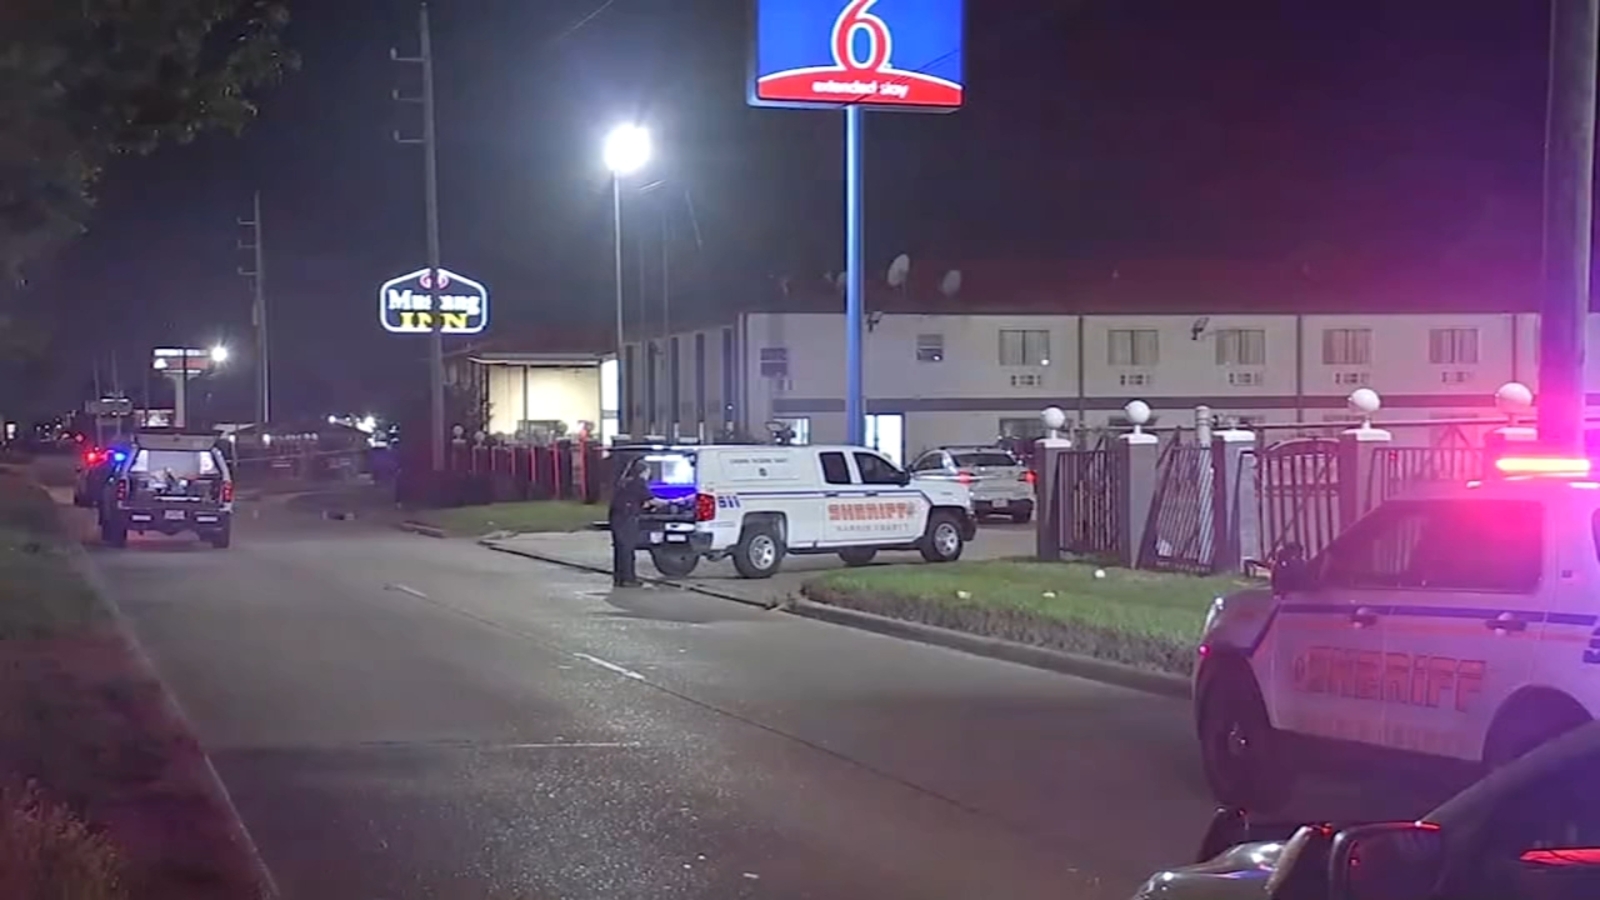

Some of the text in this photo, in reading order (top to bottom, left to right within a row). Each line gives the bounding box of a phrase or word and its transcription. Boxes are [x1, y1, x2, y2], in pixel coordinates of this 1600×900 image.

[831, 0, 892, 70] 6
[812, 80, 909, 99] extended stay
[388, 289, 481, 316] Musang
[828, 502, 907, 521] SHERIFF
[1305, 645, 1487, 714] SHERIFF
